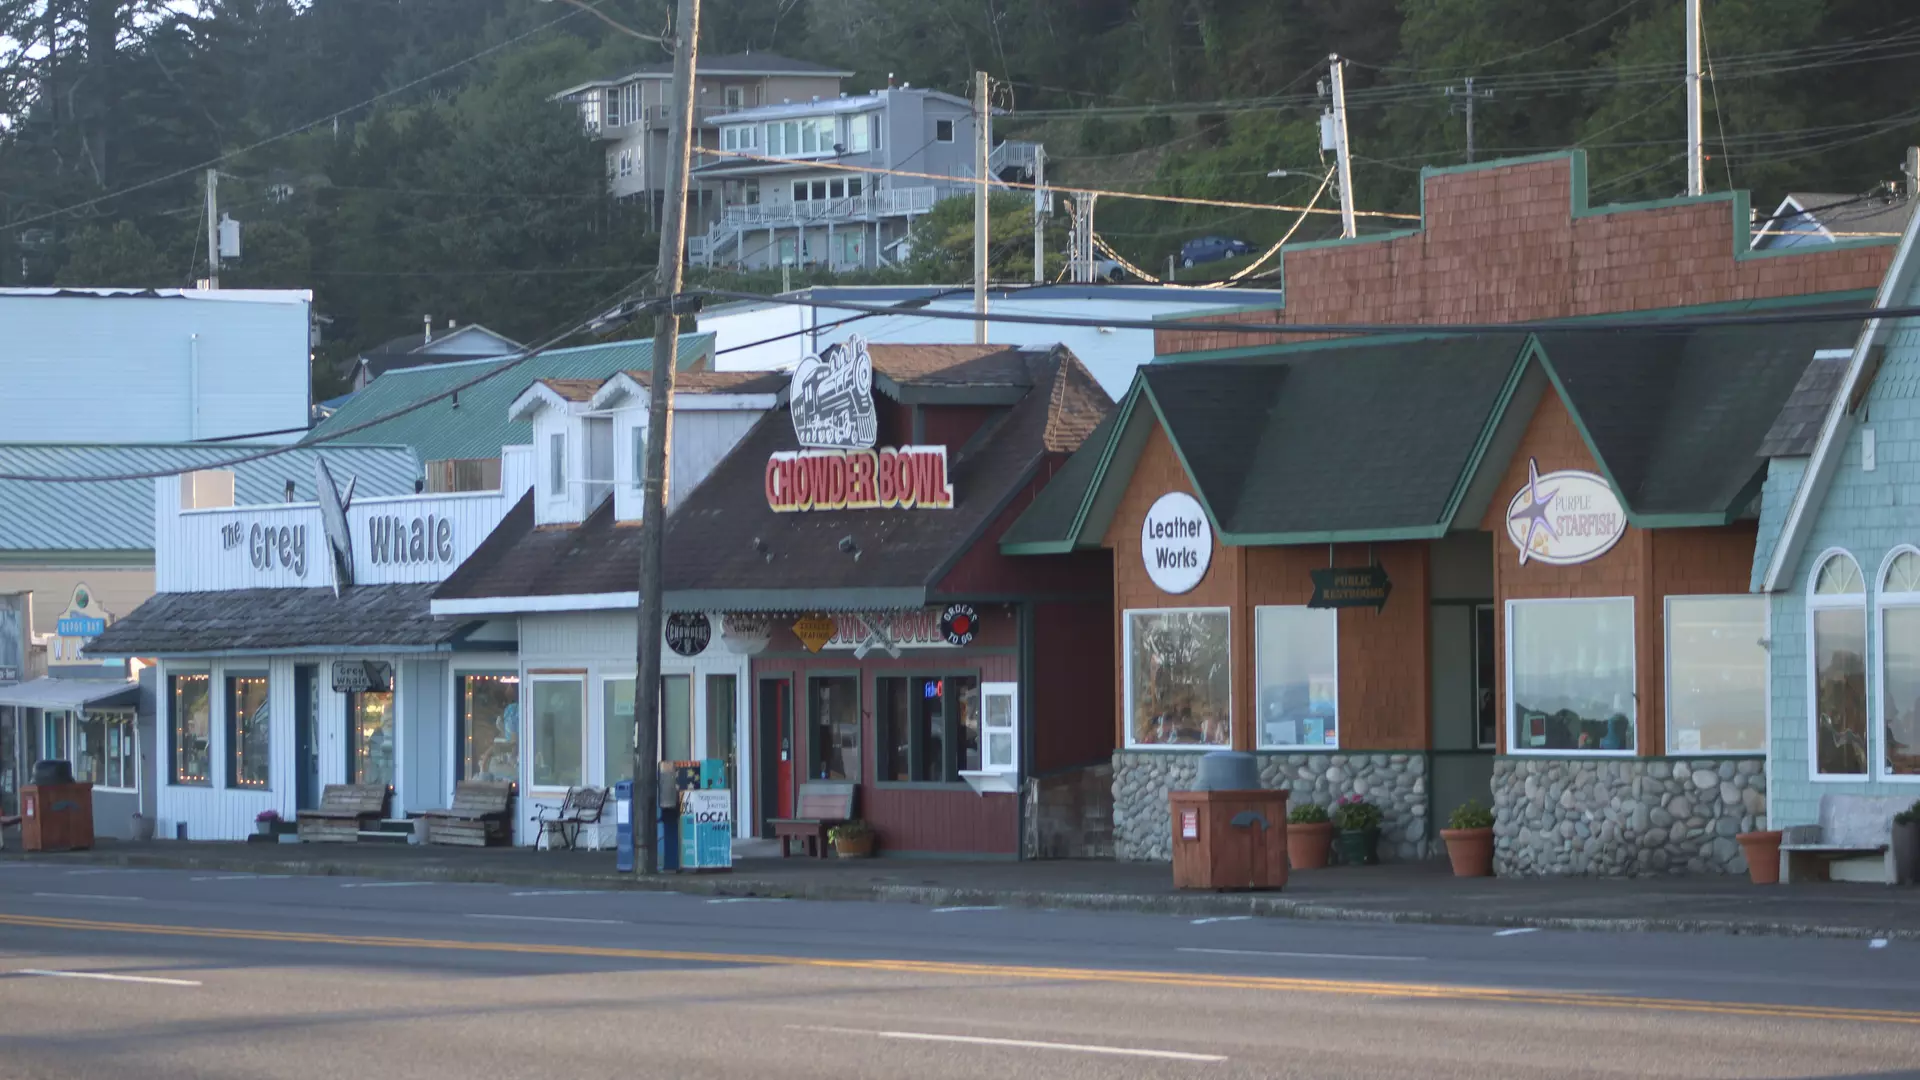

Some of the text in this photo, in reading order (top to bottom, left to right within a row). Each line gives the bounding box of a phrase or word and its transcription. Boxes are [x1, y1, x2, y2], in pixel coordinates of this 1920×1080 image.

[765, 446, 953, 510] CHOWDER BOWL
[1555, 495, 1591, 511] PURPLE
[1149, 516, 1202, 539] Leather
[1556, 513, 1616, 537] STARFISH
[221, 513, 452, 577] The Grey Whale
[1156, 547, 1197, 569] Works
[1334, 574, 1371, 586] PUBLIC
[943, 604, 977, 622] ORDERS
[948, 631, 973, 645] TO GO
[340, 666, 364, 676] Grey
[336, 676, 367, 685] Whale
[695, 811, 729, 823] LOCAL
